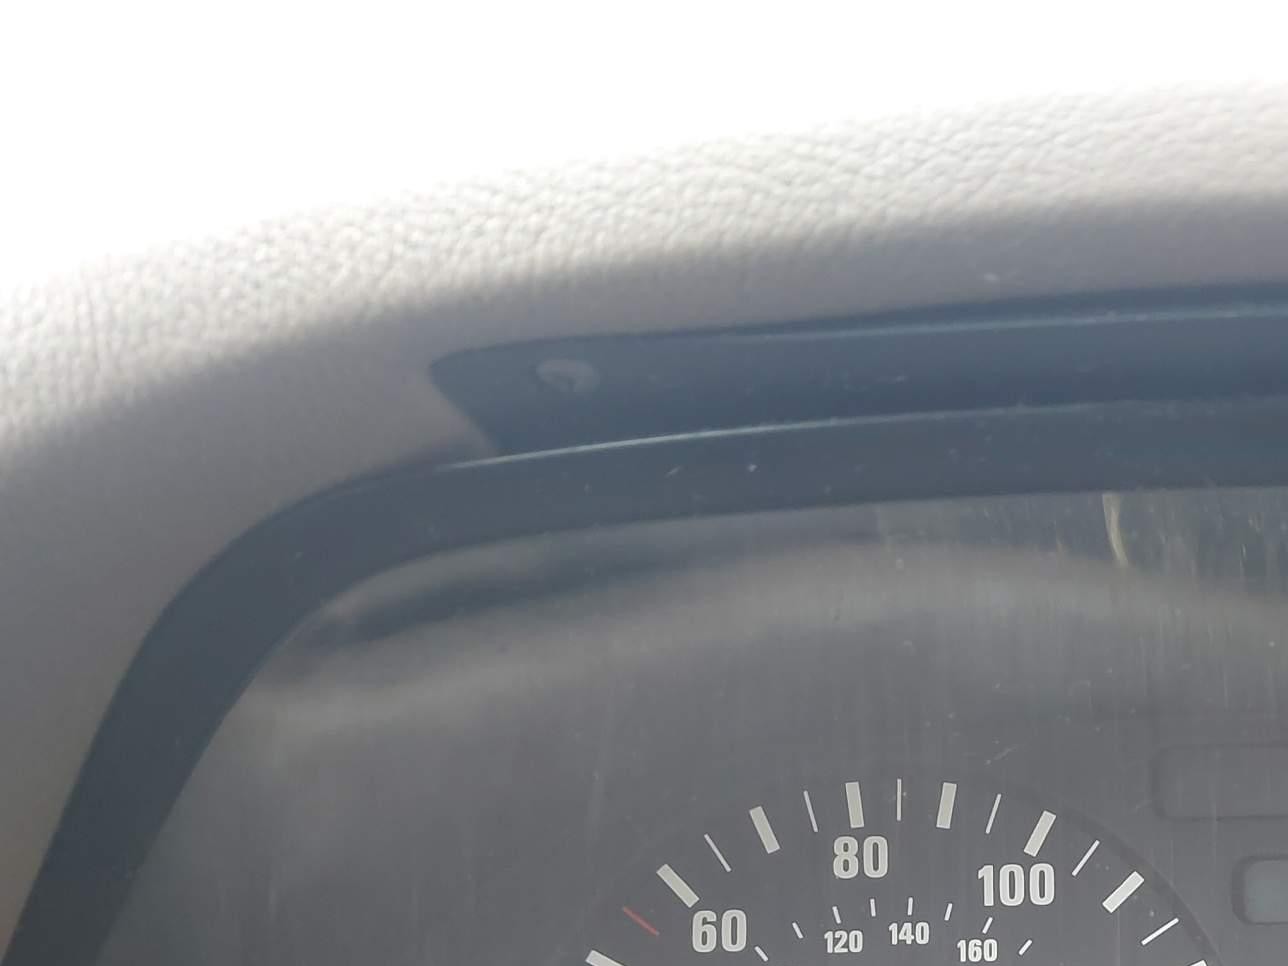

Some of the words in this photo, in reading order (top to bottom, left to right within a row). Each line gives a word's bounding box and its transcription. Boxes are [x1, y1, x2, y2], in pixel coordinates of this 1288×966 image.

[832, 836, 889, 879] 80
[978, 863, 1055, 906] 100
[691, 910, 747, 952] 60
[824, 930, 863, 954] 120
[889, 921, 930, 945] 140
[957, 938, 998, 962] 160
